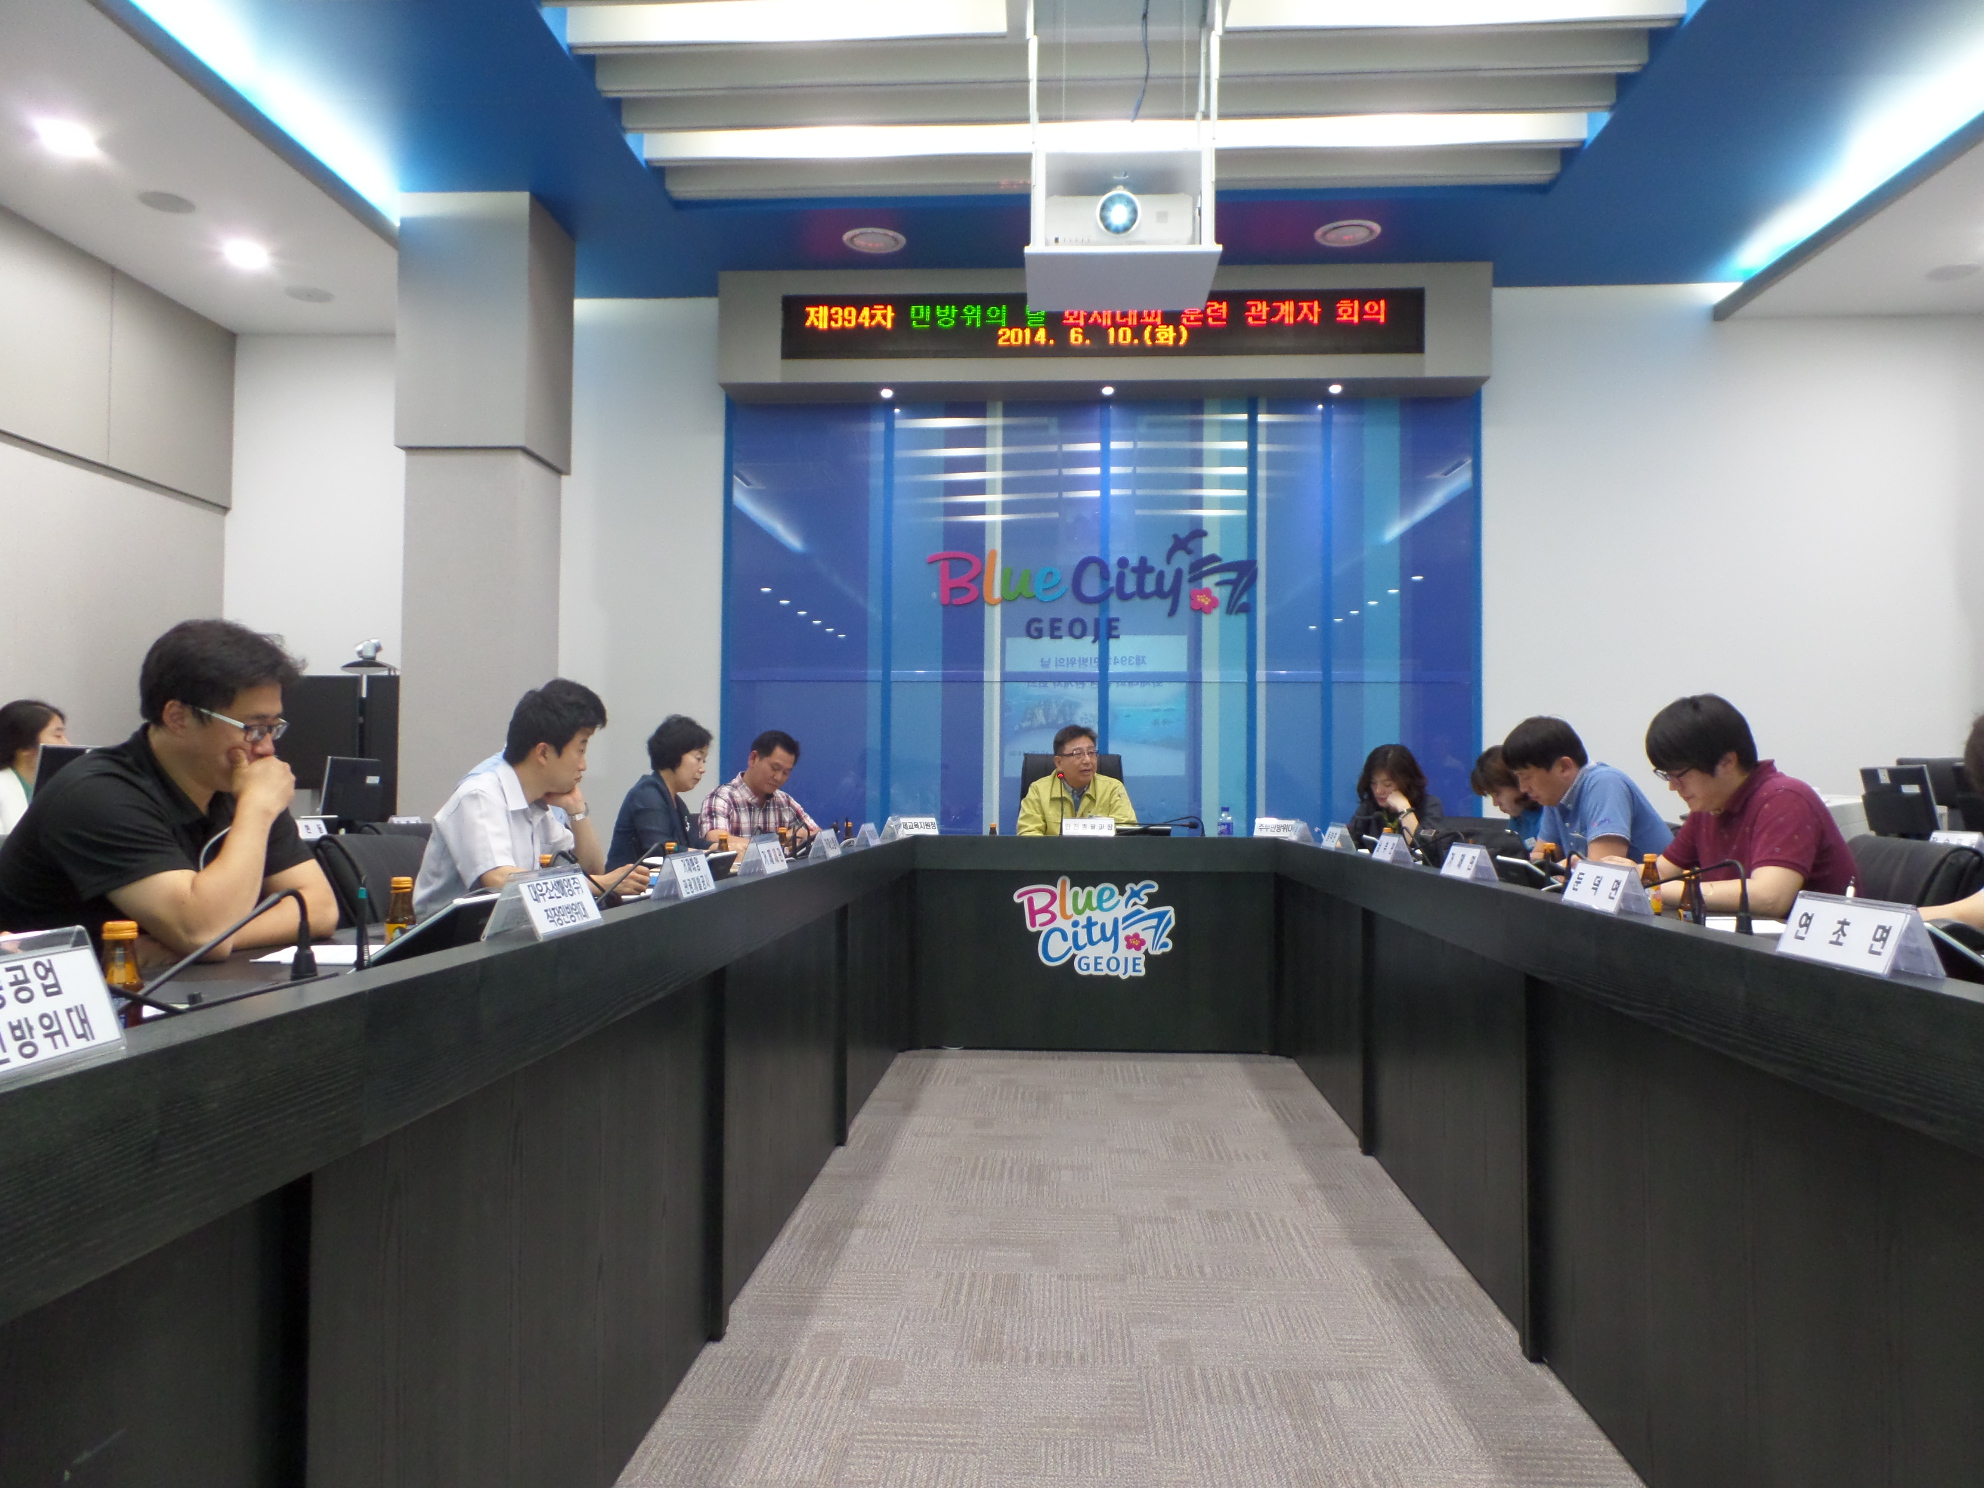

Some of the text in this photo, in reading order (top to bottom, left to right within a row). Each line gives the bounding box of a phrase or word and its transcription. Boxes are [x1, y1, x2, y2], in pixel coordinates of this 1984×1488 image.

[804, 304, 895, 329] 제394차
[910, 304, 1008, 328] 민방위의
[1244, 299, 1322, 326] 관계자
[1336, 299, 1387, 325] 회의
[997, 327, 1055, 345] 2014.
[1069, 327, 1091, 345] 6.
[926, 549, 1184, 618] Blue City
[1025, 616, 1122, 643] GEOJE
[1016, 878, 1121, 929] Blue
[1041, 915, 1120, 963] City
[0, 959, 64, 1010] 공업
[1077, 955, 1143, 976] GEOJE
